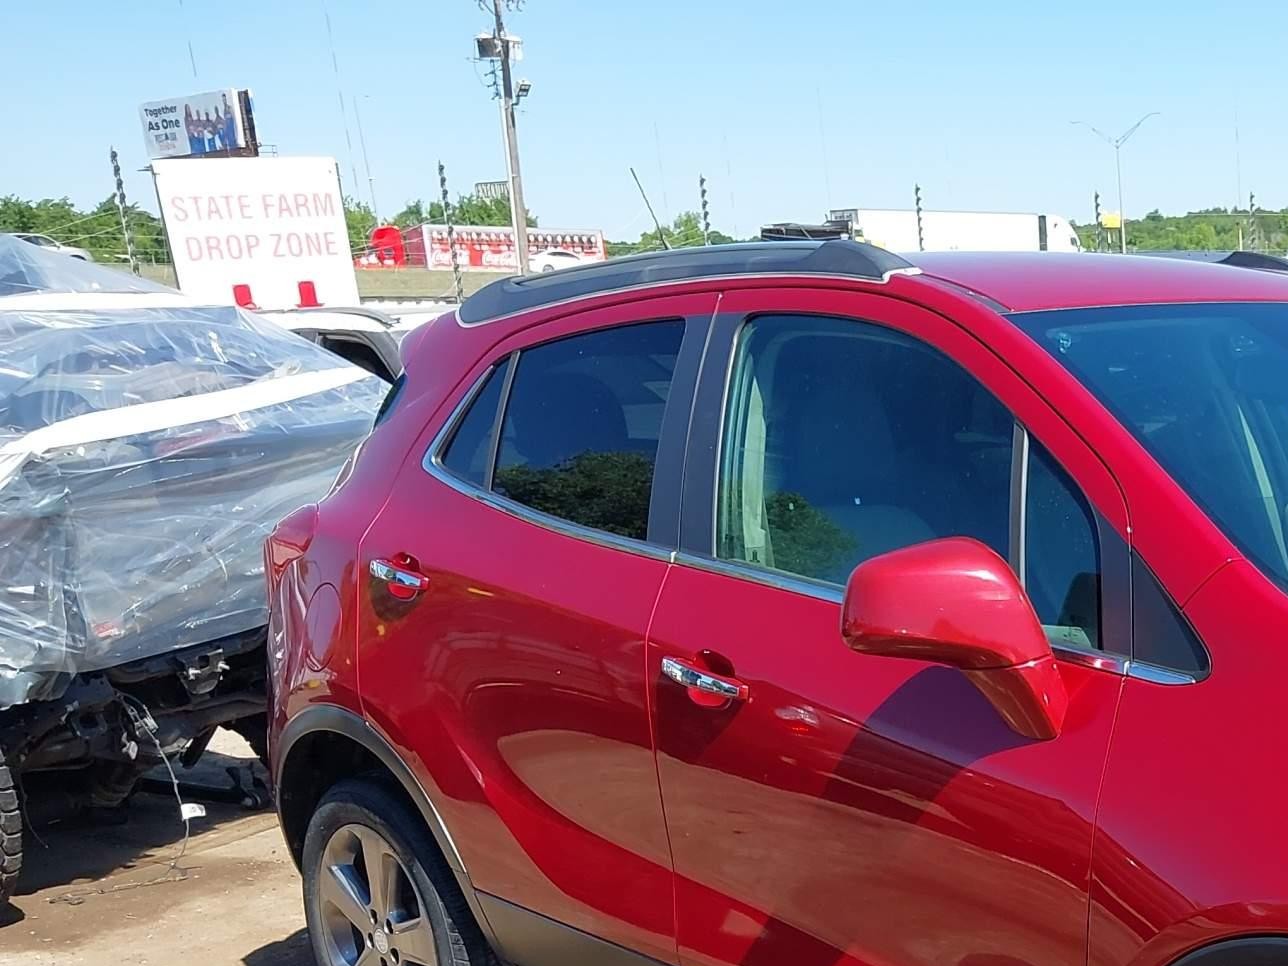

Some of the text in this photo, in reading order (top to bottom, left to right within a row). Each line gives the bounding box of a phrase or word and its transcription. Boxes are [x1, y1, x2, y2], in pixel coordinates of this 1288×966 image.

[144, 105, 177, 118] Together
[148, 119, 181, 132] As One
[171, 192, 336, 222] STATE FARM
[185, 231, 339, 262] DROP ZONE
